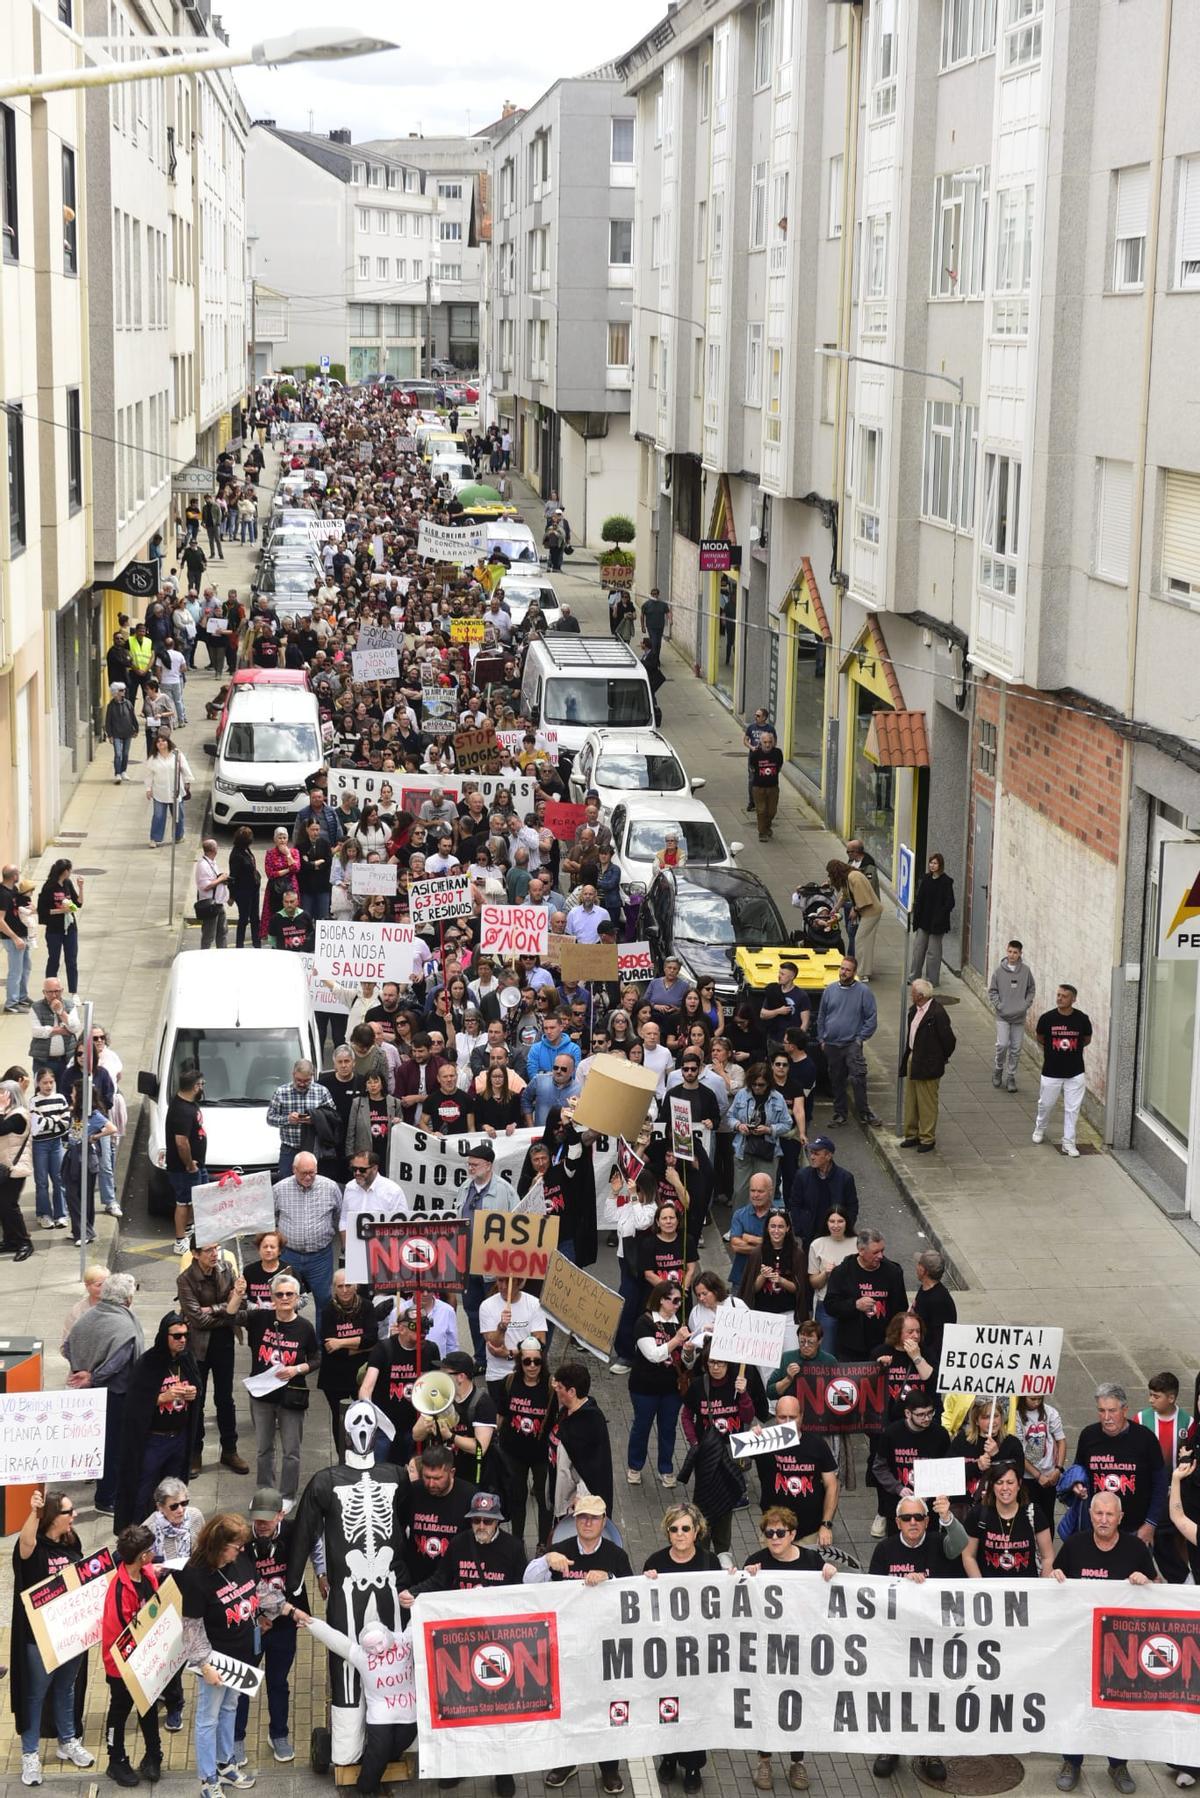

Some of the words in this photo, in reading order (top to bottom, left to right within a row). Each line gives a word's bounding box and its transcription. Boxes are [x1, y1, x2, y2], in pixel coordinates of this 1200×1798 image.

[702, 542, 729, 550] MODA
[602, 567, 632, 576] STOP
[363, 626, 393, 641] SOMOS
[366, 660, 386, 668] NON
[455, 729, 495, 749] STOP
[458, 745, 498, 767] BIOGAS
[456, 890, 464, 902] T
[413, 910, 424, 922] DE
[484, 907, 546, 931] SURRO
[381, 927, 413, 943] NON
[498, 930, 541, 952] NON
[320, 943, 345, 958] POLA
[352, 944, 386, 959] NOSA
[332, 961, 385, 978] SAUDE
[368, 1234, 467, 1279] NON
[483, 1248, 548, 1277] NON
[555, 1258, 563, 1272] O
[552, 1275, 572, 1297] NON
[976, 1327, 1043, 1346] XUNTA!
[1030, 1353, 1052, 1369] NA
[939, 1374, 1015, 1393] LARACHA
[1021, 1374, 1055, 1394] NON
[796, 1376, 885, 1417] NON
[46, 1425, 60, 1440] DE
[775, 1473, 814, 1497] NON
[1094, 1472, 1136, 1495] NON
[77, 1550, 114, 1583] NON
[46, 1579, 107, 1622] QUEREMOS
[620, 1577, 783, 1624] BIOGÁS
[828, 1583, 897, 1620] ASÍ
[940, 1591, 1029, 1628] NON
[478, 1633, 490, 1641] NA
[491, 1626, 539, 1640] LARACHA?
[1148, 1621, 1160, 1632] NA
[602, 1632, 867, 1680] MORREMOS
[909, 1633, 1000, 1680] NÓS
[435, 1638, 550, 1697] NON
[734, 1688, 753, 1729] E
[778, 1689, 802, 1732] O
[833, 1685, 1046, 1733] ANLLÓNS
